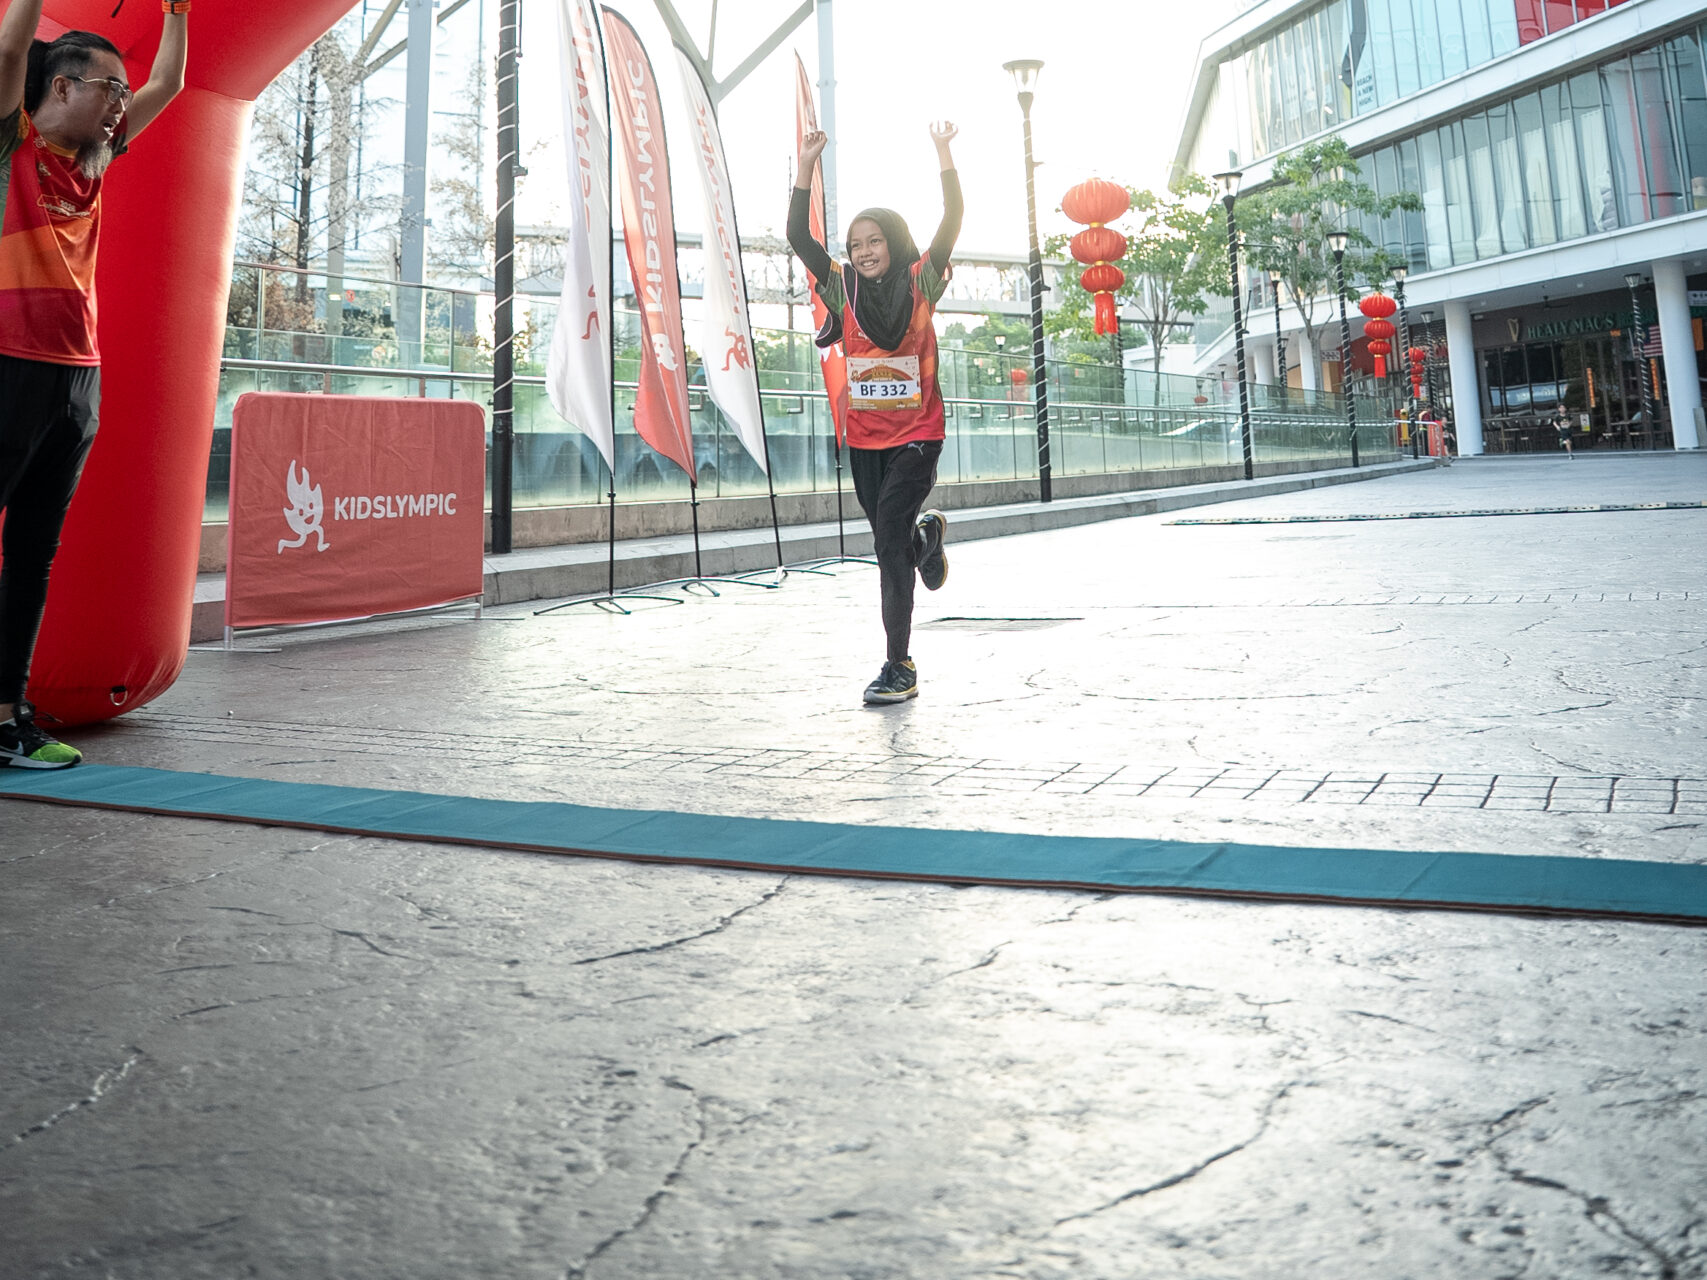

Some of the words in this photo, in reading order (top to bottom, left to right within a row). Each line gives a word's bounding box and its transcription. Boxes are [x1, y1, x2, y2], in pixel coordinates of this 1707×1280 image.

[1527, 320, 1570, 339] HEALY
[1574, 313, 1614, 333] MAC'S
[860, 384, 877, 397] BF
[880, 383, 908, 397] 332
[334, 492, 457, 521] KIDSLYMPIC
